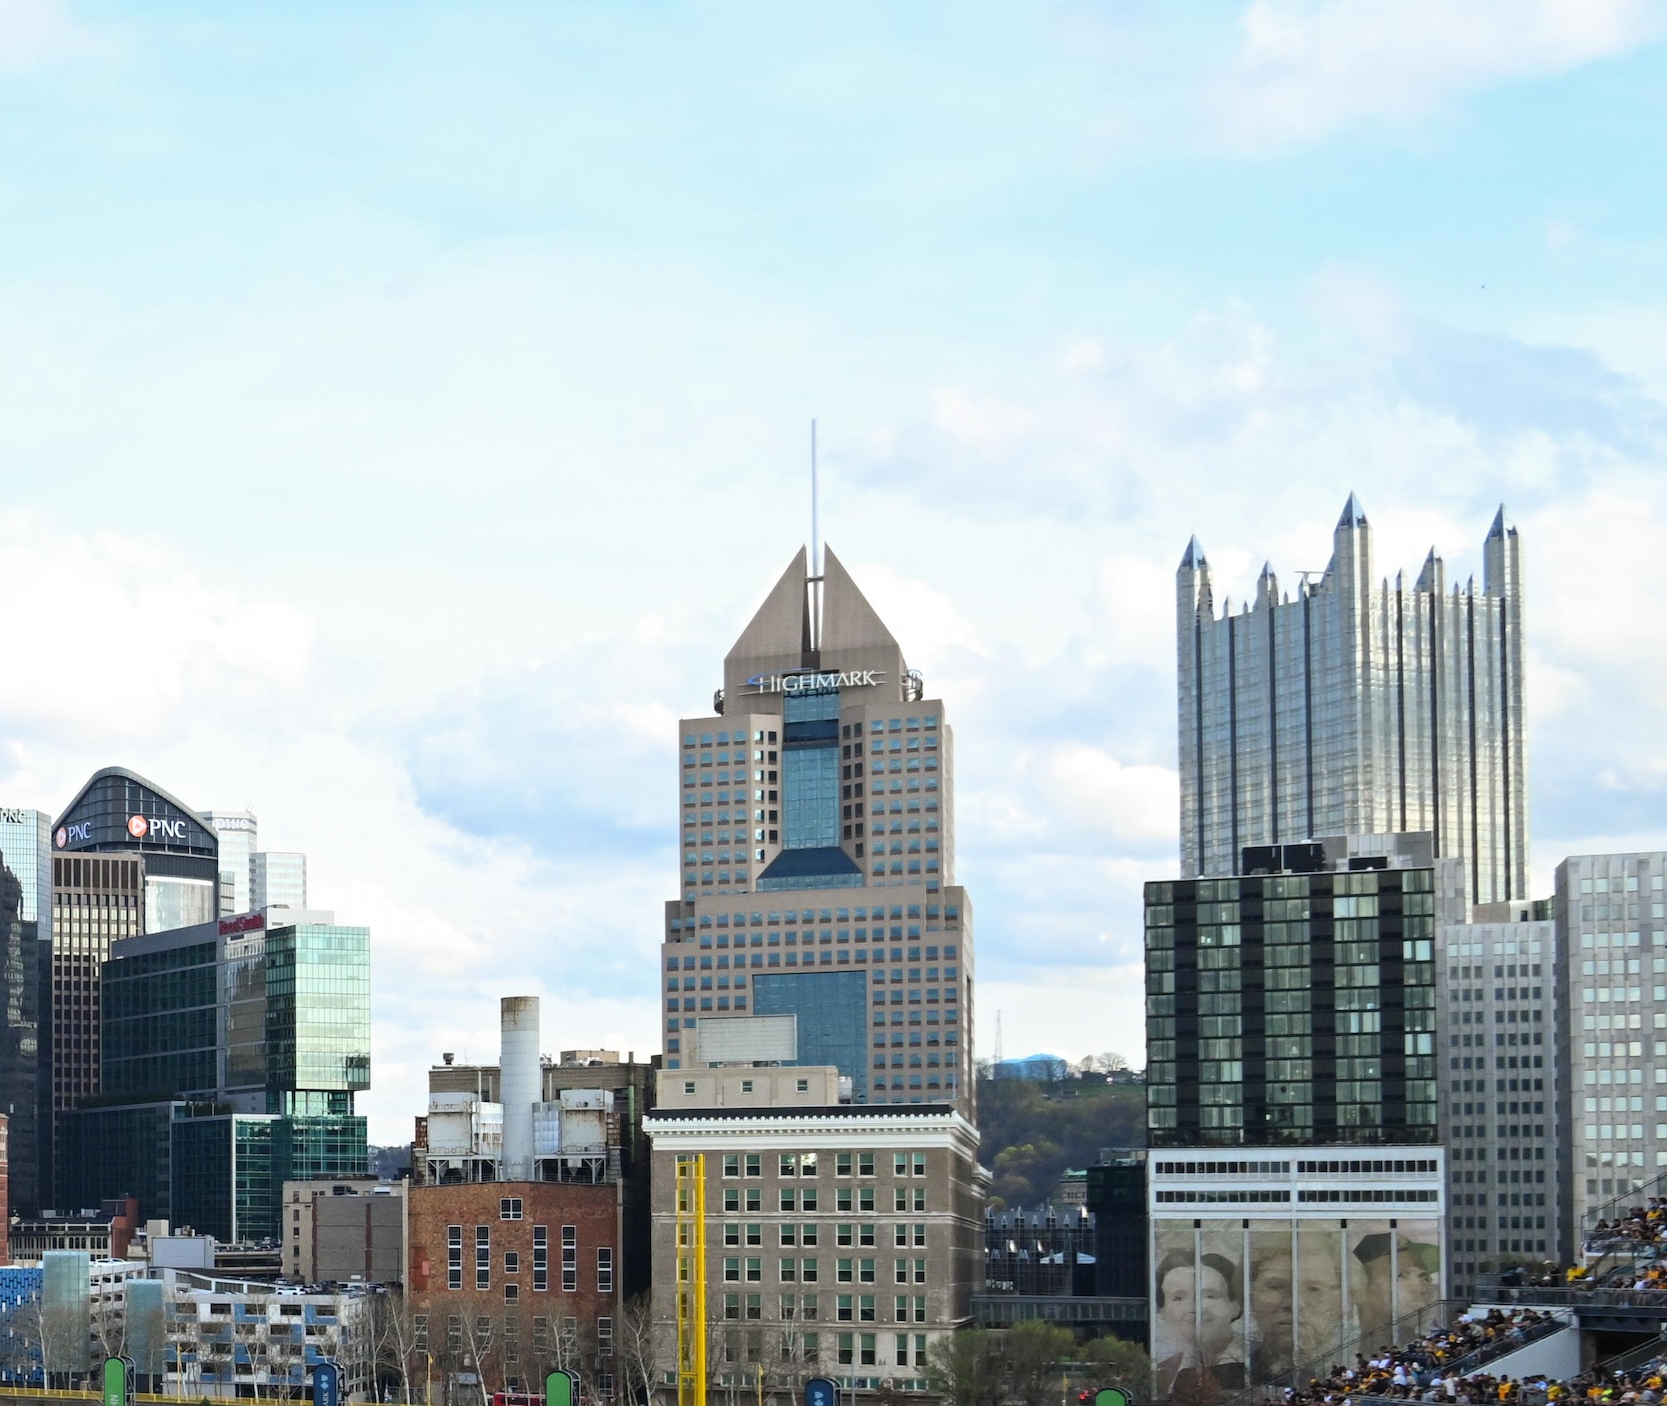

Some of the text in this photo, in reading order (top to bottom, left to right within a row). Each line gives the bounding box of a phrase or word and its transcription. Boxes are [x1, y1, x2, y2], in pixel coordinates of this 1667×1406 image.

[759, 670, 877, 693] HIGHMARK
[67, 822, 91, 843] PNC
[149, 818, 186, 838] PNC
